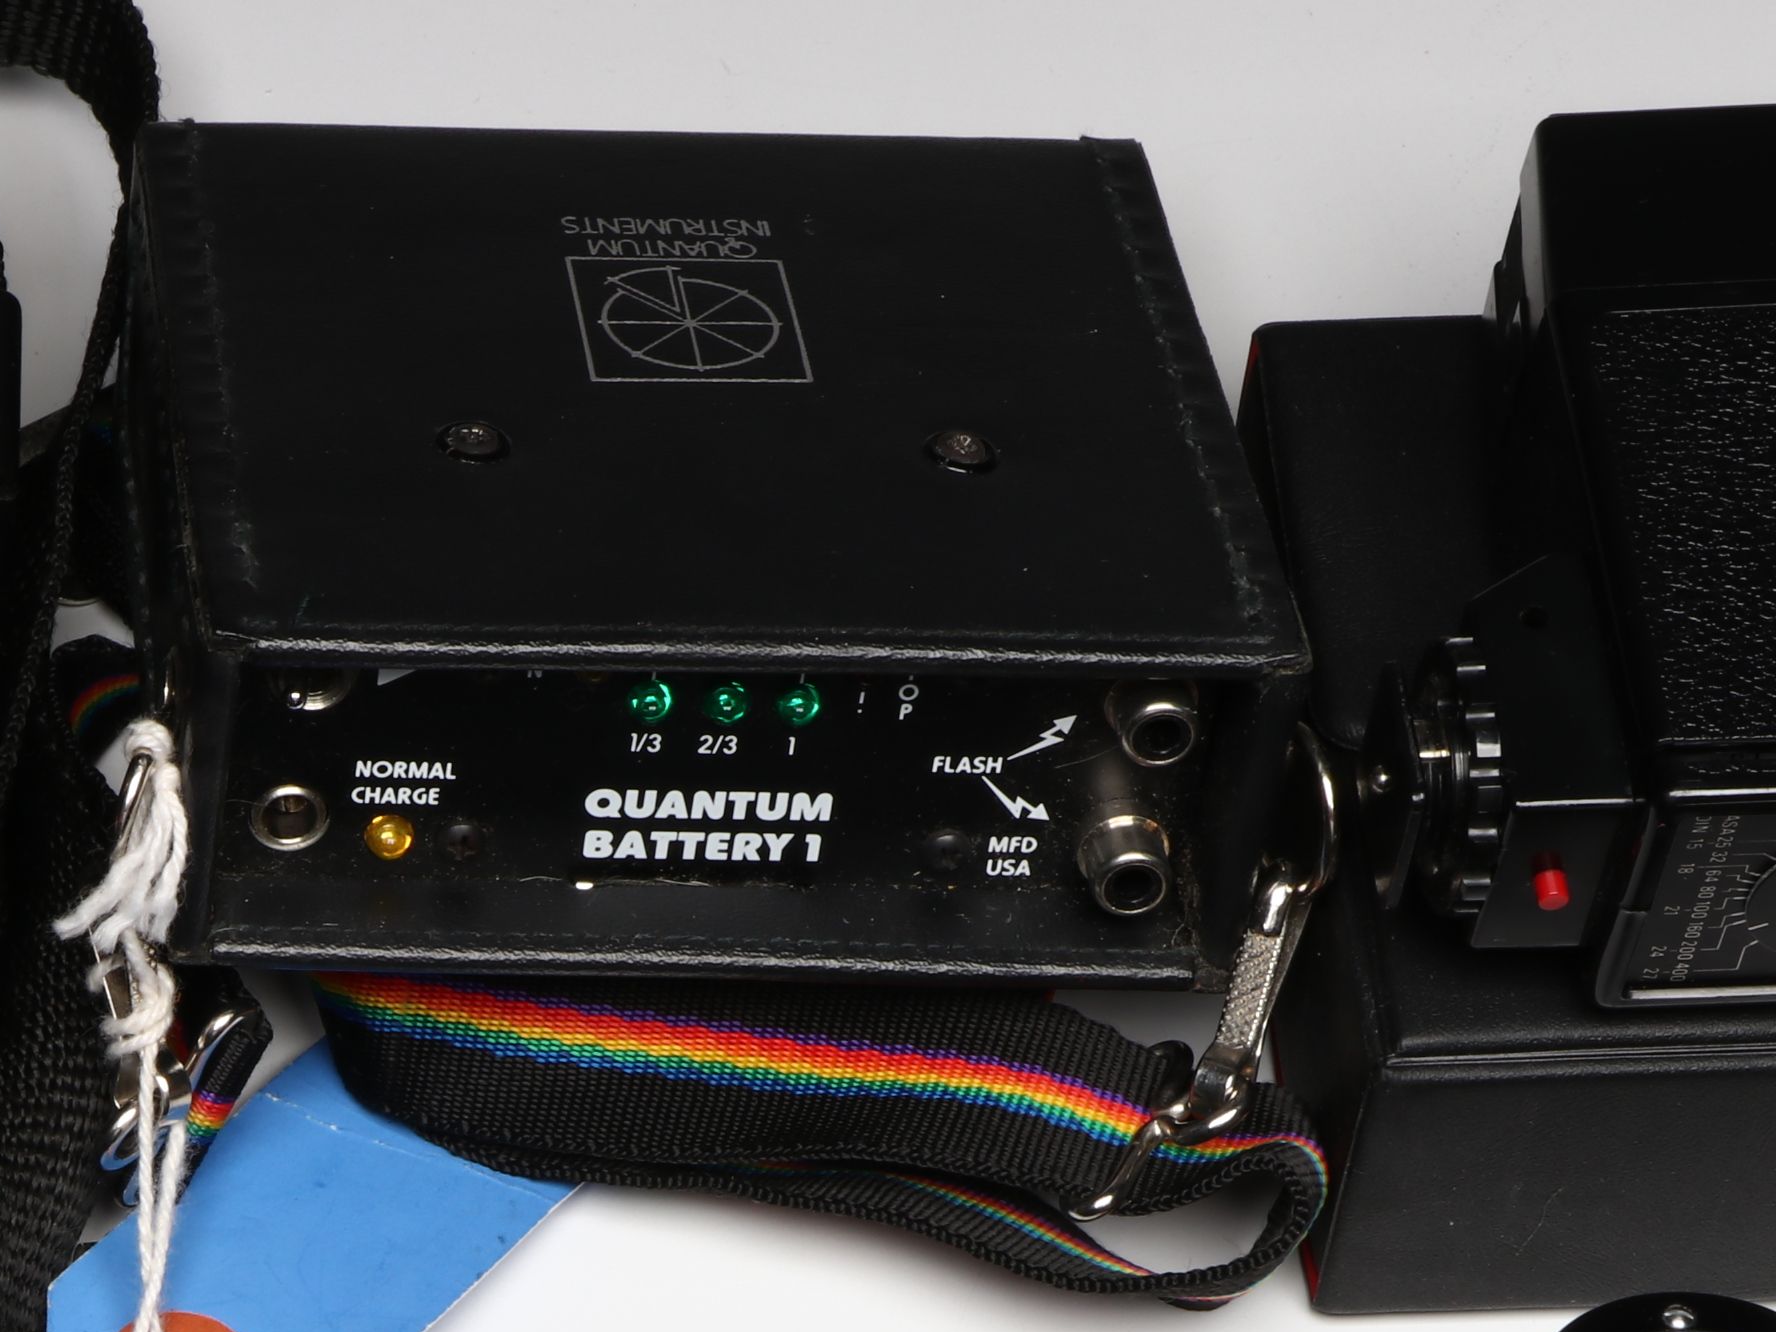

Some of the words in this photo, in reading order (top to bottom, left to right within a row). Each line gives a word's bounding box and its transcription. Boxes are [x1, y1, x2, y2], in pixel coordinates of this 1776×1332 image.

[560, 216, 772, 238] INSTRUMENTS
[587, 238, 757, 259] QUANTUM
[629, 733, 662, 754] 1/3
[697, 735, 739, 756] 2/3
[786, 736, 797, 757] 1
[354, 760, 456, 781] NORMAL
[931, 756, 1004, 775] FLASH
[350, 786, 441, 806] CHARGE
[583, 788, 835, 823] QUANTUM
[1720, 815, 1741, 835] ASA
[581, 829, 795, 863] BATTERY
[805, 833, 823, 863] 1
[987, 836, 1038, 853] MFD
[1686, 839, 1704, 850] 15
[1715, 836, 1734, 848] 25
[1709, 851, 1728, 863] 32
[986, 858, 1032, 878] USA
[1678, 863, 1695, 874] 18
[1705, 869, 1722, 882] 64
[1698, 887, 1717, 899] 80
[1664, 906, 1680, 916] 21
[1691, 902, 1711, 919] 100
[1684, 921, 1703, 938] 160
[1649, 946, 1667, 958] 24
[1677, 941, 1697, 960] 200
[1642, 968, 1660, 980] 27
[1670, 963, 1691, 982] 400
